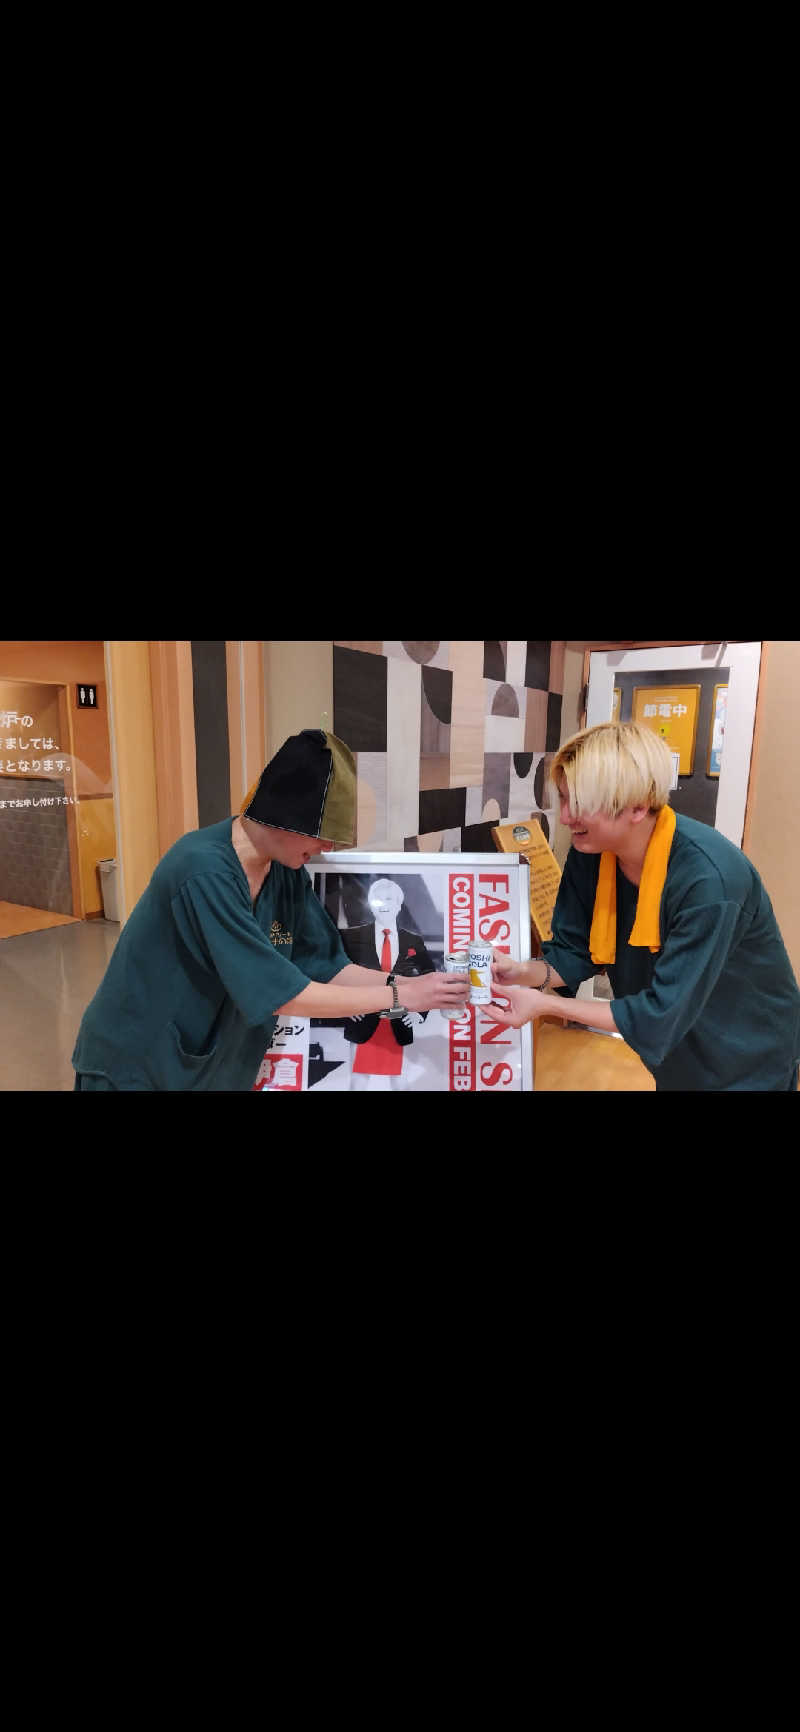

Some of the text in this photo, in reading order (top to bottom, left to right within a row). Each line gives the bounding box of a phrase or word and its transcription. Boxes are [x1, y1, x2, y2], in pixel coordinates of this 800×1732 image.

[0, 737, 60, 750] ましては、
[0, 760, 71, 772] となります。
[453, 877, 471, 952] COMIN
[453, 1047, 471, 1091] FEB
